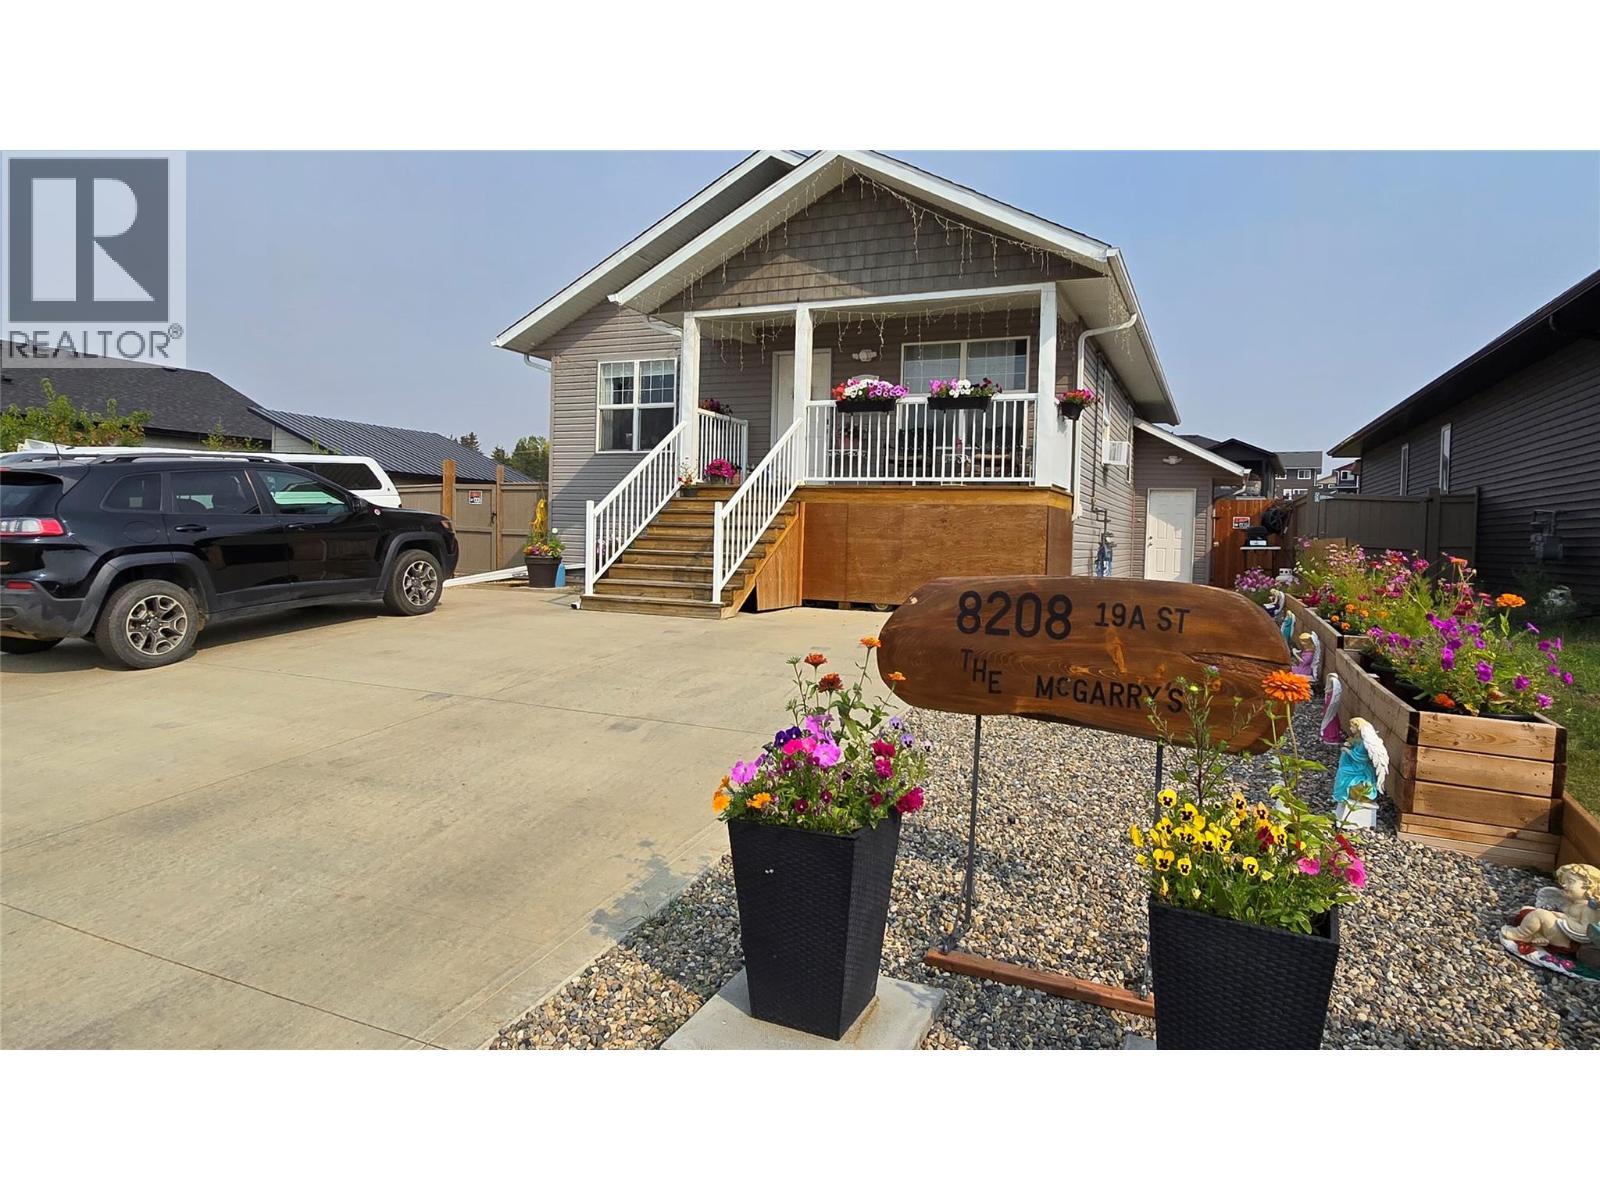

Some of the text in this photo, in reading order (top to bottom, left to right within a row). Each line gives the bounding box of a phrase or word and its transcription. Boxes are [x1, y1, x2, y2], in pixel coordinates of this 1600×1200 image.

[957, 591, 1191, 640] 8208 19A ST
[961, 648, 1002, 694] THE
